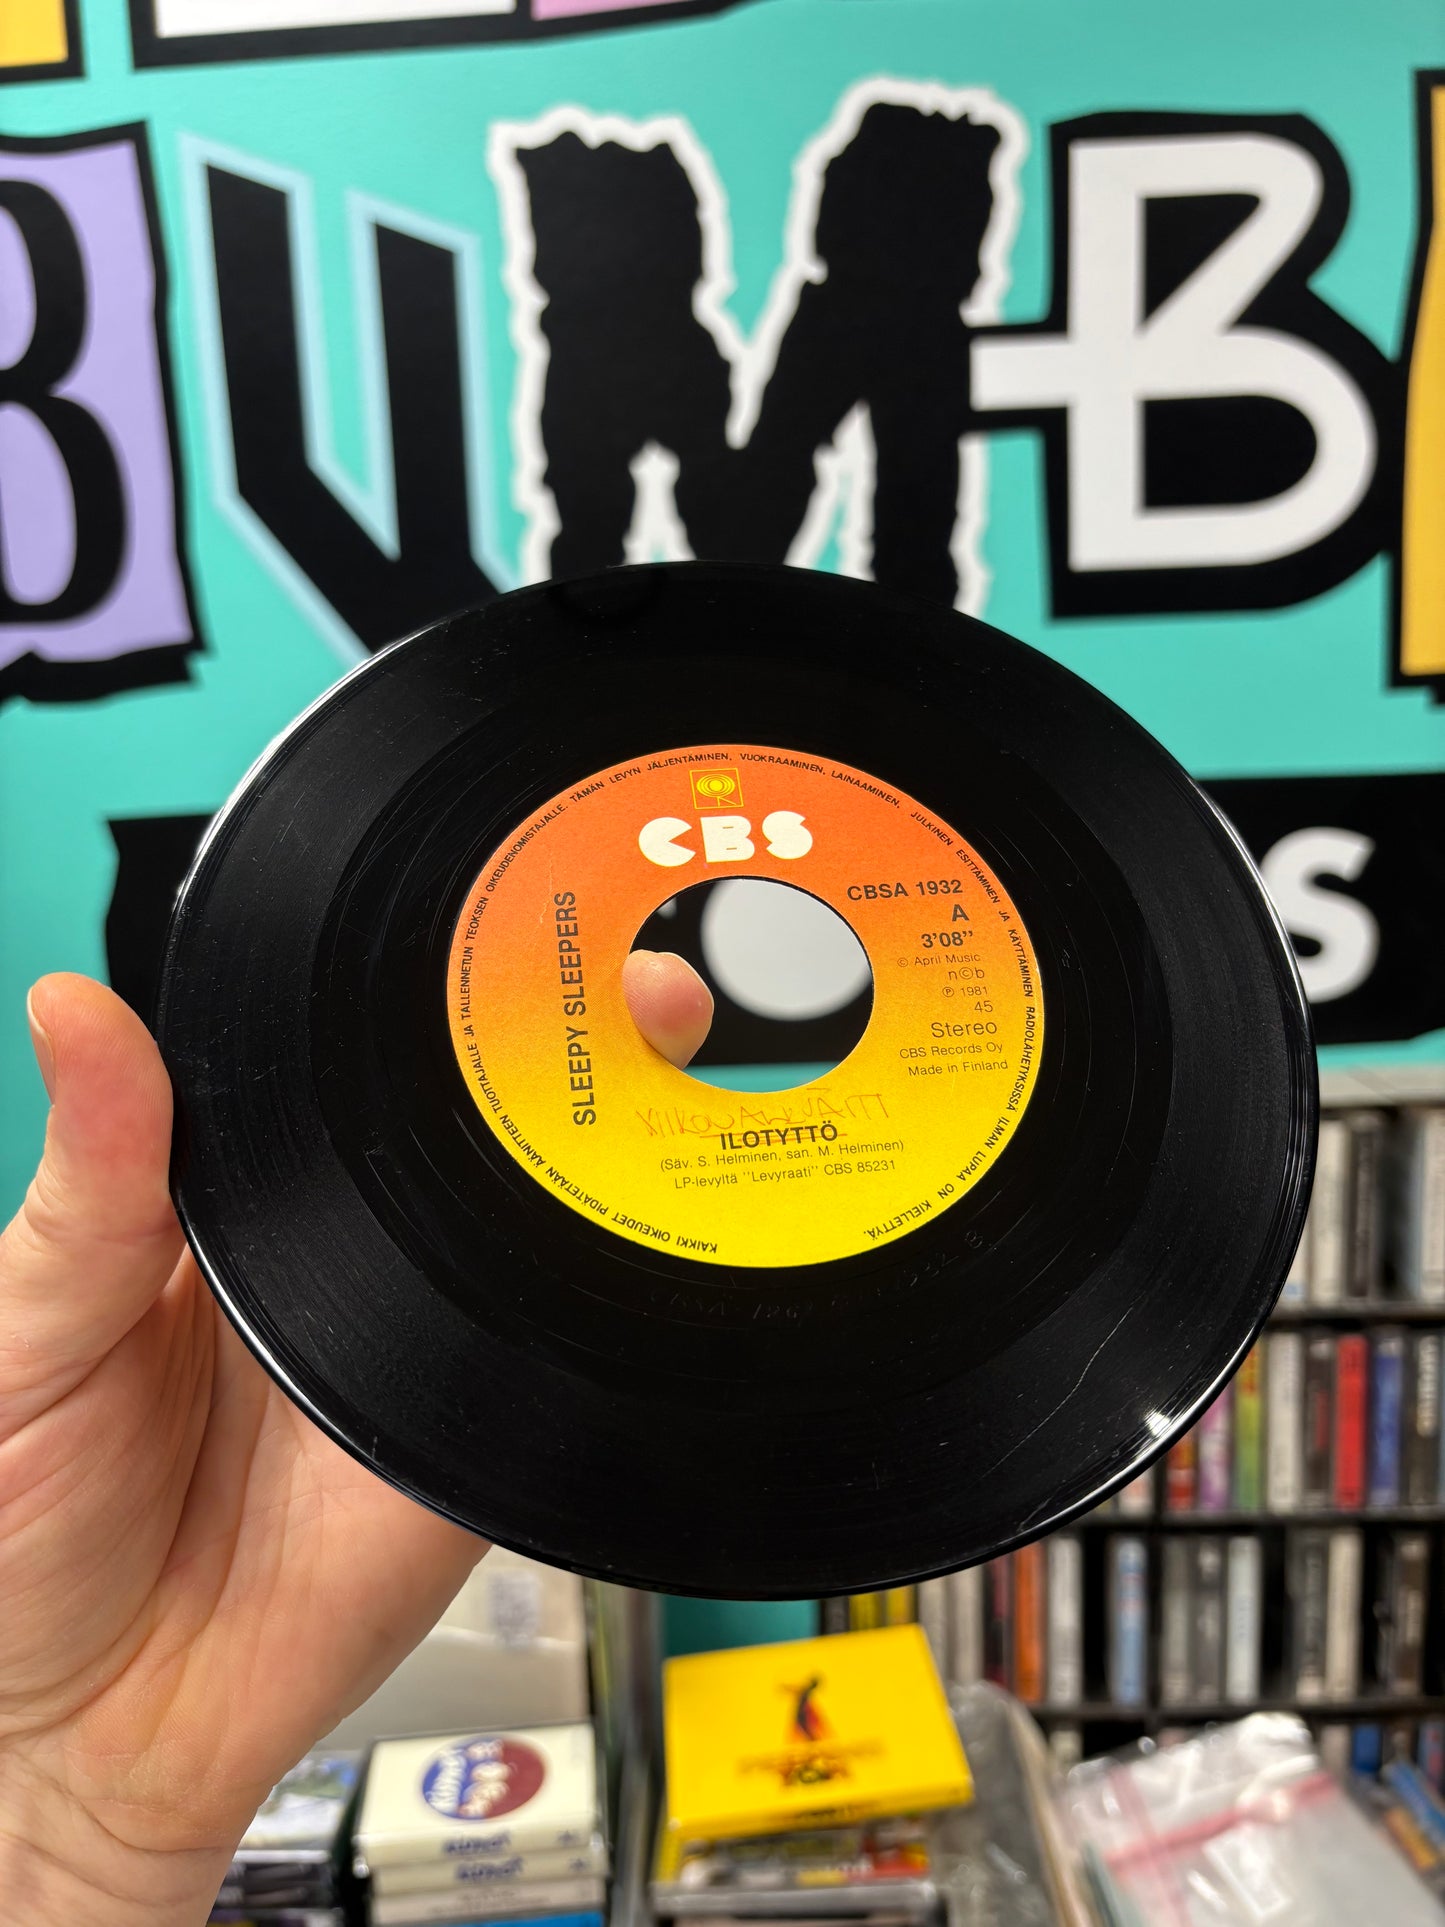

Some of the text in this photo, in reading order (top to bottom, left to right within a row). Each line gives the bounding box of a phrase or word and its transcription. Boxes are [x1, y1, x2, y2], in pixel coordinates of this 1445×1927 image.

[609, 767, 641, 784] LEVYN
[570, 782, 604, 803] TÄMÄN
[638, 810, 813, 867] CBS
[910, 811, 953, 846] JULKINEN
[485, 804, 568, 892] OIKEUDENOMISTAJALLE.
[847, 879, 963, 901] CBSA 1932
[956, 849, 1000, 903] ESITTÄMINEN
[465, 897, 489, 941] TEOKSEN
[951, 904, 969, 922] A
[998, 910, 1010, 922] JA
[914, 955, 941, 967] April
[945, 953, 981, 964] Music
[1008, 929, 1033, 997] KÄYTTÄMINEN
[460, 946, 474, 1020] TALLENNETUN
[961, 986, 988, 996] 1981
[554, 891, 596, 1126] SLEEPY SLEEPERS
[974, 1000, 993, 1013] 45
[464, 1024, 474, 1037] JA
[931, 1021, 997, 1038] Stereo
[900, 1042, 1003, 1059] CBS Records Oy
[1006, 1006, 1036, 1112] RADIOLÄHETYKSISSÄ
[467, 1043, 503, 1114] TUOTTAJALLE
[908, 1059, 1008, 1076] Made in Finland
[500, 1115, 546, 1168] ÄÄNITTEEN
[720, 1120, 838, 1150] ILOTYTTÖ
[984, 1116, 1010, 1150] ILMAN
[660, 1139, 904, 1172] (Säv. S. Helminen, san. M. Helminen)
[956, 1151, 986, 1181] LUPAA
[674, 1172, 738, 1190] LP-levyltä
[824, 1163, 852, 1176] CBS
[857, 1159, 896, 1173] 85231
[545, 1167, 609, 1215] PIDÄTETÄÄN
[937, 1183, 955, 1199] ON
[612, 1212, 671, 1242] OIKEUDET
[676, 1235, 718, 1253] KAIKKI
